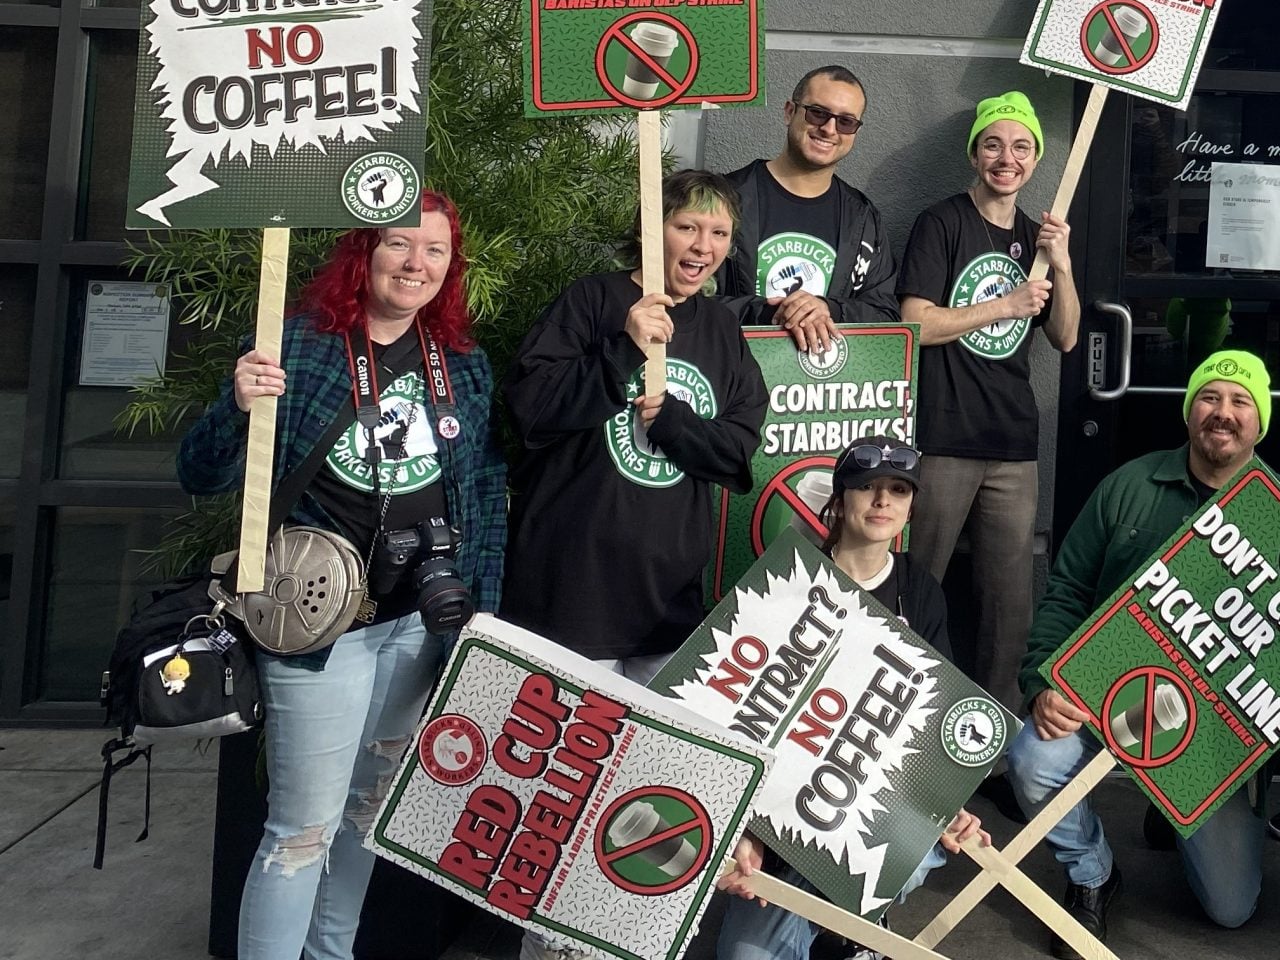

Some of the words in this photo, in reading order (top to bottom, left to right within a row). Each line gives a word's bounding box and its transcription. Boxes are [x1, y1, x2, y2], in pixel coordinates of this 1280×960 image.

[1170, 1, 1201, 16] STRIKE
[245, 24, 324, 69] NO
[182, 46, 398, 133] COFFEE!
[1176, 131, 1234, 154] Have
[1244, 143, 1259, 156] a
[353, 156, 410, 175] STARBUCKS
[346, 186, 379, 218] WORKERS
[390, 186, 414, 215] UNITED
[762, 241, 834, 274] STARBUCKS
[970, 260, 1023, 286] STARBUCK
[1002, 319, 1025, 348] UNITE
[356, 355, 370, 396] Canon
[430, 352, 441, 367] 5D
[829, 351, 844, 372] UNITED
[1093, 337, 1102, 384] PULL
[433, 369, 447, 397] EOS
[770, 380, 913, 413] CONTRACT,
[764, 416, 914, 454] STARBUCKS!
[1192, 502, 1278, 593] DON'T
[438, 614, 461, 622] Canon
[1133, 558, 1241, 674] PICKET
[1213, 587, 1275, 658] OUR
[706, 635, 769, 704] NO
[1127, 602, 1183, 663] BARISTAS
[1177, 659, 1199, 682] ON
[1192, 676, 1220, 703] ULP
[1213, 701, 1257, 748] STRIKE
[786, 687, 848, 758] NO
[795, 642, 923, 832] COFFEE!
[945, 701, 979, 741] STARBUCKS
[988, 708, 1003, 739] UNITED
[956, 746, 994, 762] WORKERS
[436, 783, 523, 890] RED
[492, 672, 571, 779] CUP
[486, 689, 632, 920] REBELLION
[542, 867, 569, 913] UNFAIR
[563, 826, 589, 869] LABOR
[583, 767, 617, 827] PRACTICE
[611, 723, 638, 769] STRIKE
